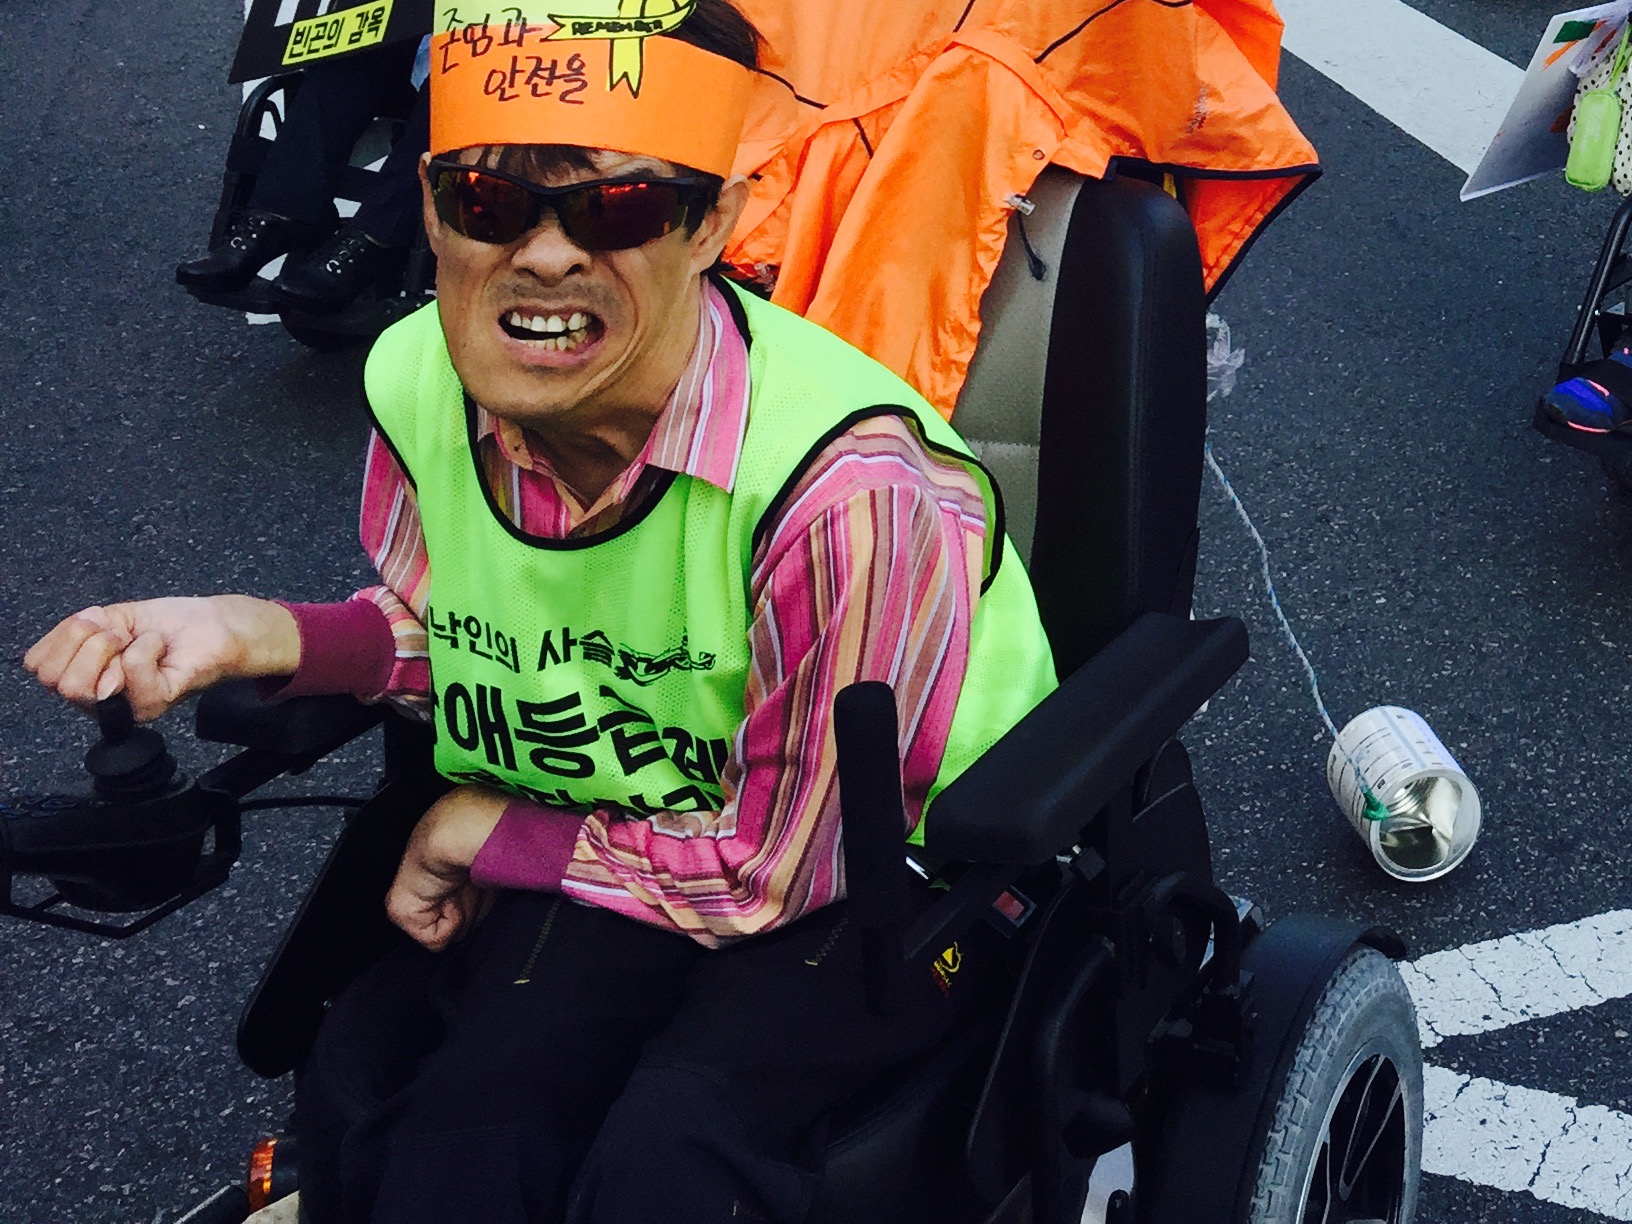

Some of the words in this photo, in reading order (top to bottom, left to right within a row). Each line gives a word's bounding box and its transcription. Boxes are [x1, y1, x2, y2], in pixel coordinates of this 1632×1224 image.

[287, 17, 346, 60] 빈곤의
[347, 5, 386, 46] 감옥
[483, 52, 589, 105] 안전을
[429, 605, 521, 674] 낙인의
[537, 626, 615, 672] 사슬
[431, 681, 733, 784] 애등급제
